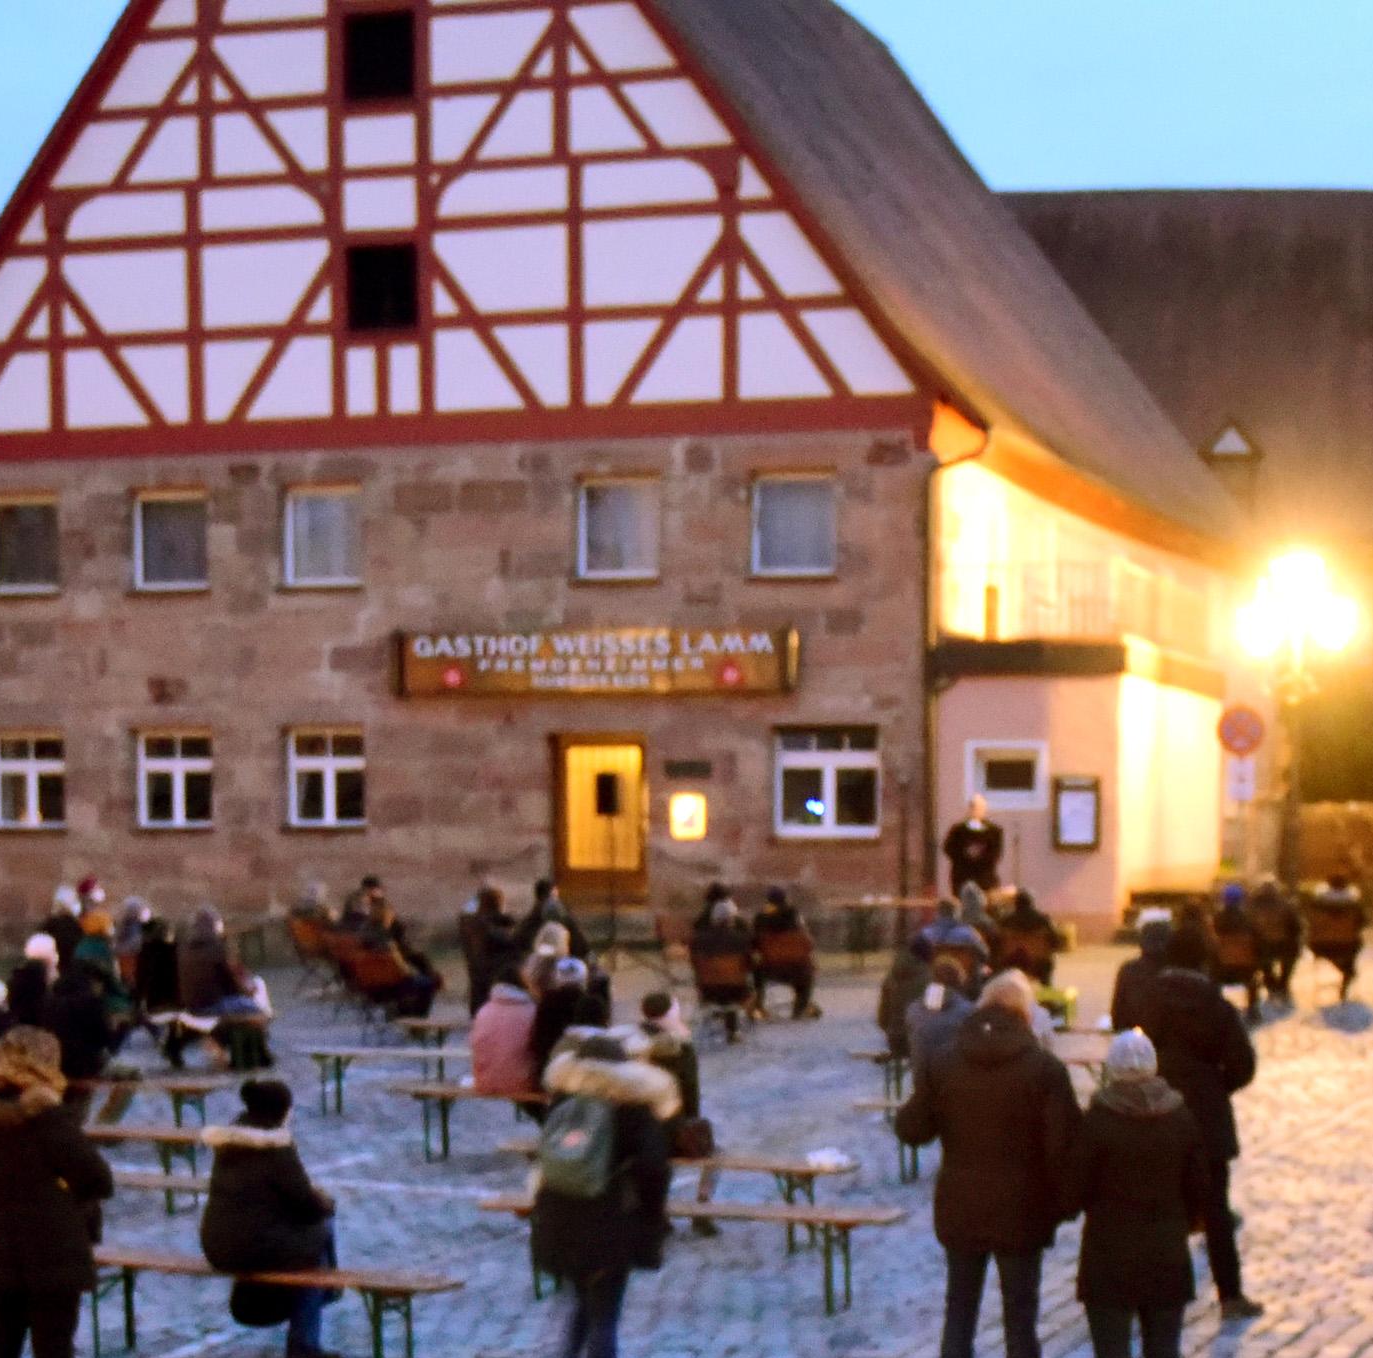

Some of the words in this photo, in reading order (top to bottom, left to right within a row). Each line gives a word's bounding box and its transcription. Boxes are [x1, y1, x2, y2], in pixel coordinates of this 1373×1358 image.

[413, 634, 540, 657] GASTHOF
[552, 633, 671, 657] WEISSES
[681, 632, 774, 655] LAMM
